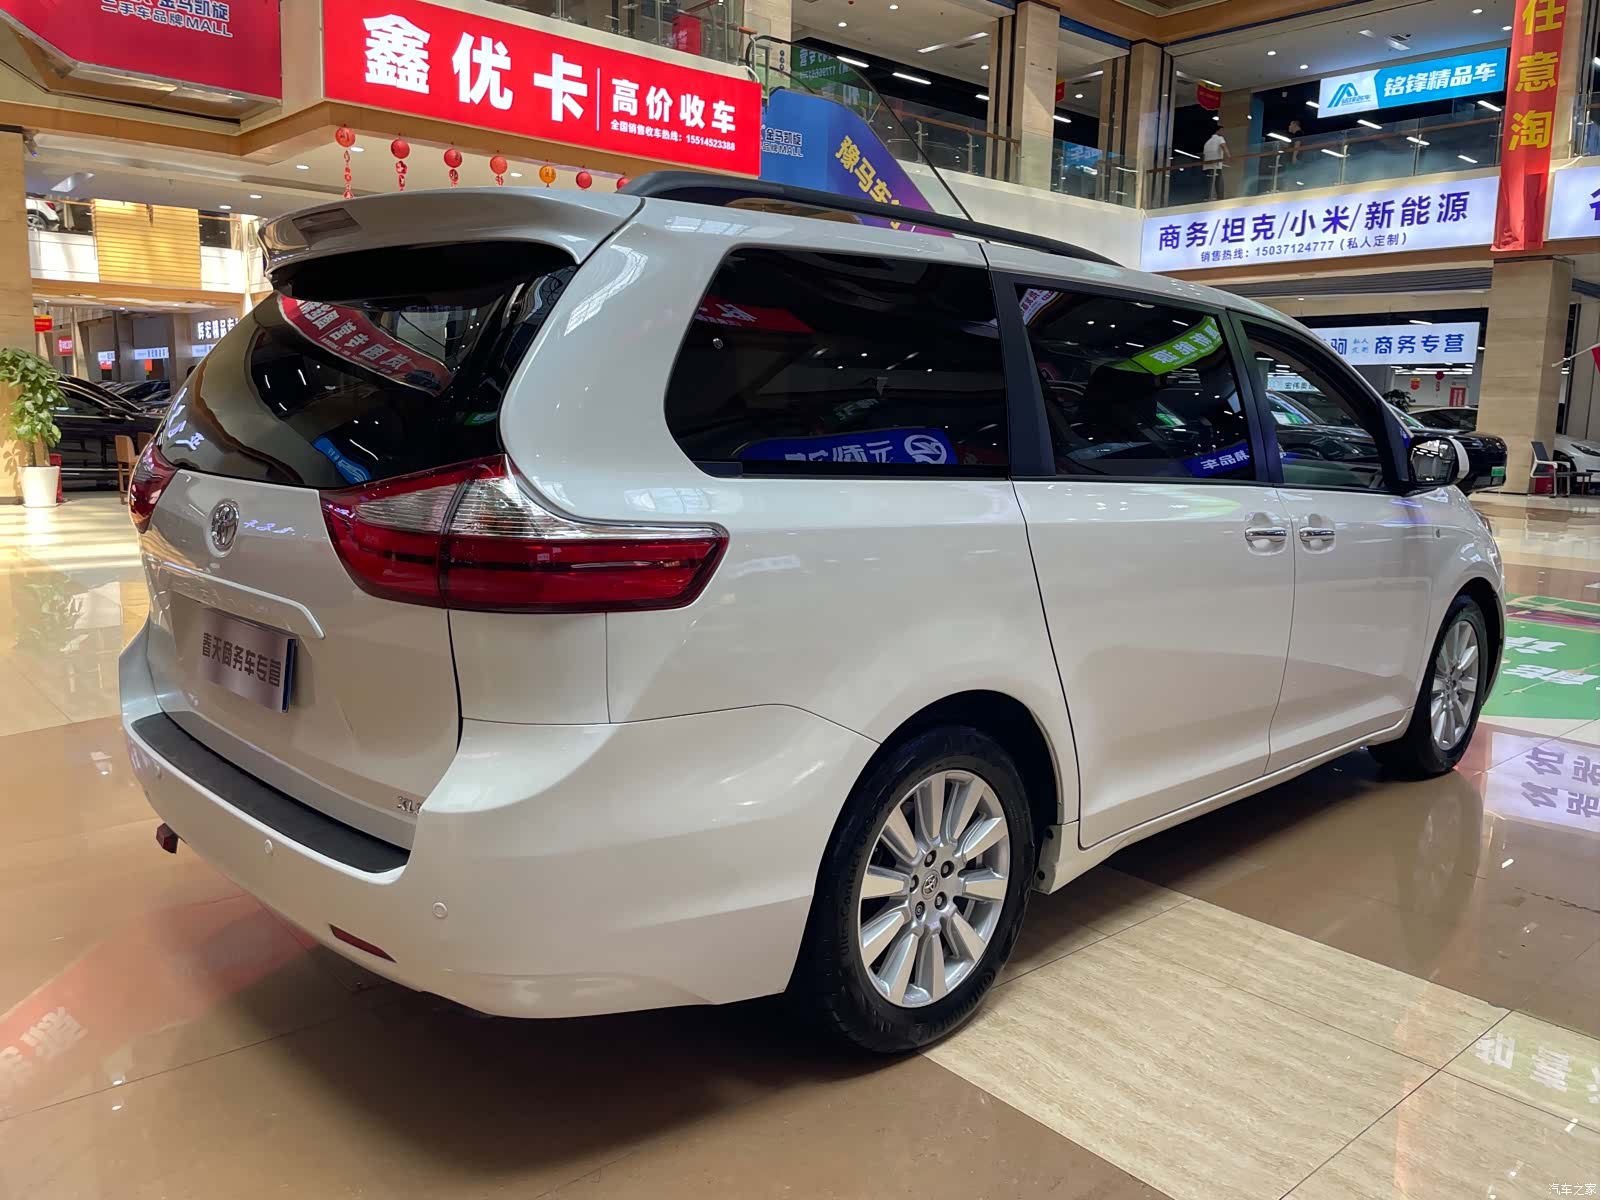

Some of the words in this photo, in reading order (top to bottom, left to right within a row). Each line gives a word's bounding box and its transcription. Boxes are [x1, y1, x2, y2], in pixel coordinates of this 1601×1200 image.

[101, 5, 233, 37] 二手车品牌MALL
[362, 13, 589, 122] 鑫优卡
[1384, 62, 1497, 97] 铭锋精品车
[611, 78, 736, 134] 高价收车
[765, 127, 802, 146] 金马凯旋
[835, 135, 900, 206] 豫马车
[1158, 191, 1470, 250] 商务/坦克/小米/新能源
[1375, 333, 1465, 355] 商务专营
